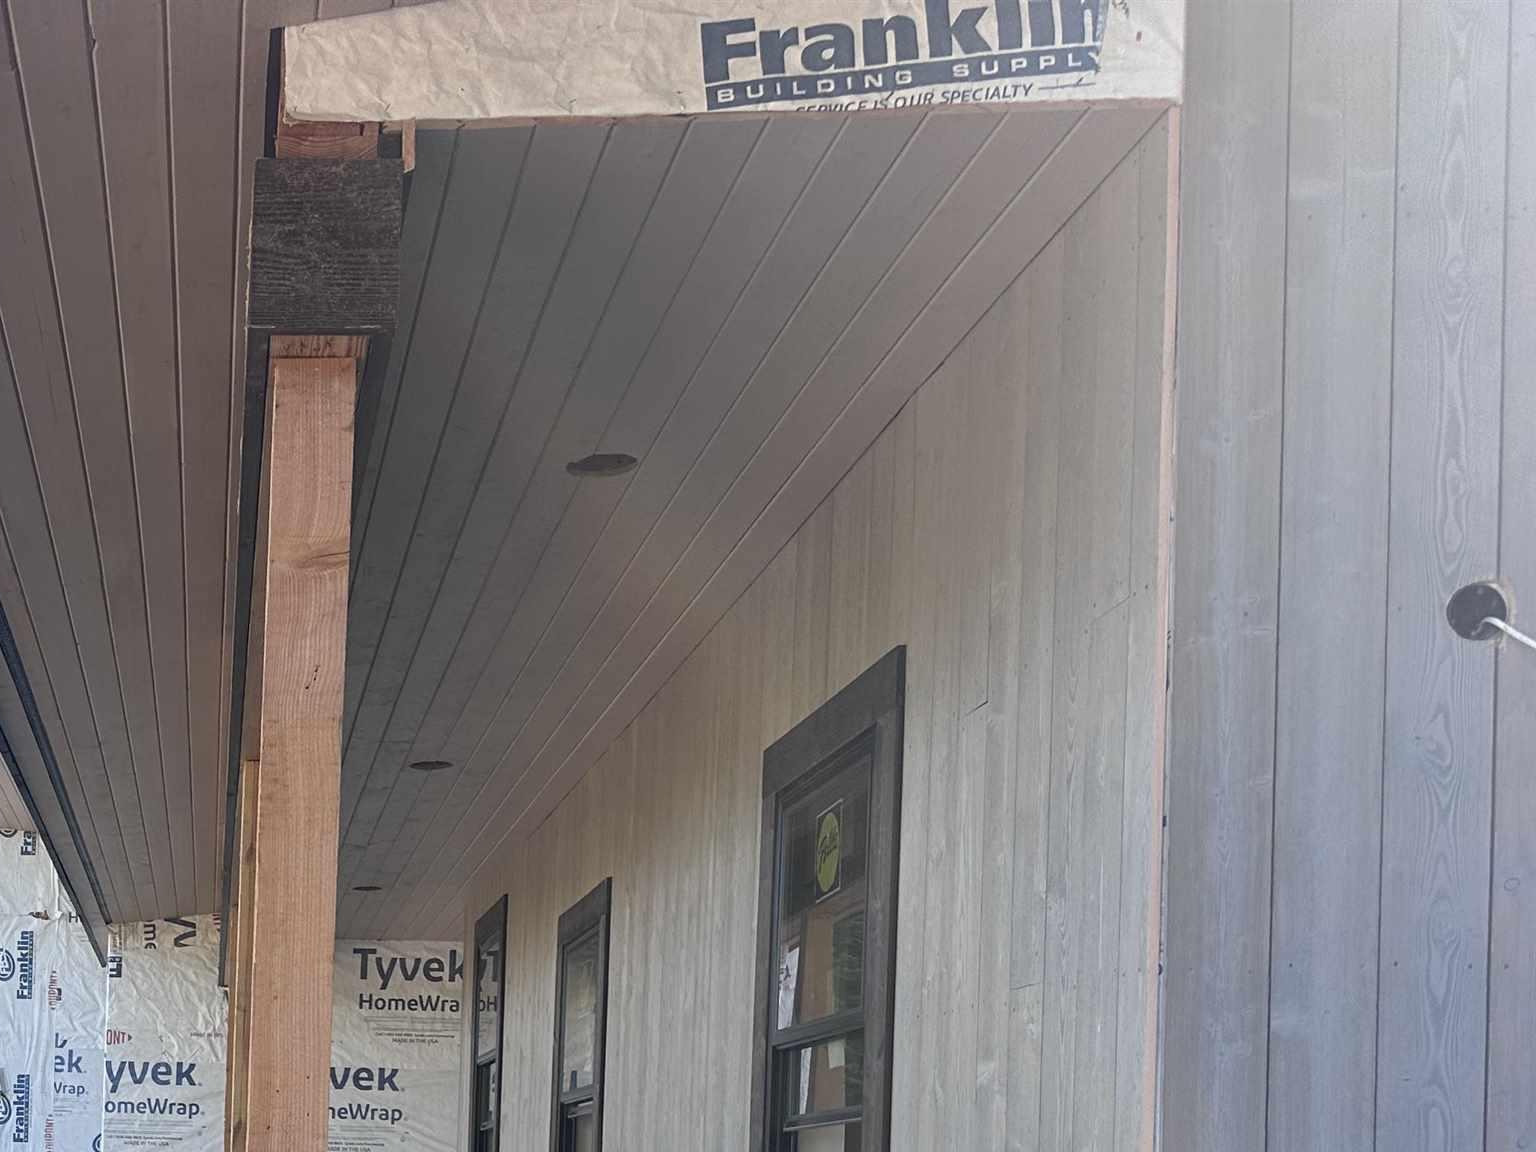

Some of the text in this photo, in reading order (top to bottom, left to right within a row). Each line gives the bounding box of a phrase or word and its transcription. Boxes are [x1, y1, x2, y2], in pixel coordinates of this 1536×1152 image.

[717, 69, 913, 103] BUILDING
[796, 100, 867, 112] RVICE
[894, 91, 935, 109] OUR
[941, 83, 1034, 106] SPECIALTY
[16, 931, 30, 999] Franklin
[353, 948, 464, 990] Tyvek
[13, 1074, 26, 1142] Franklin
[104, 1098, 200, 1119] omeWrap
